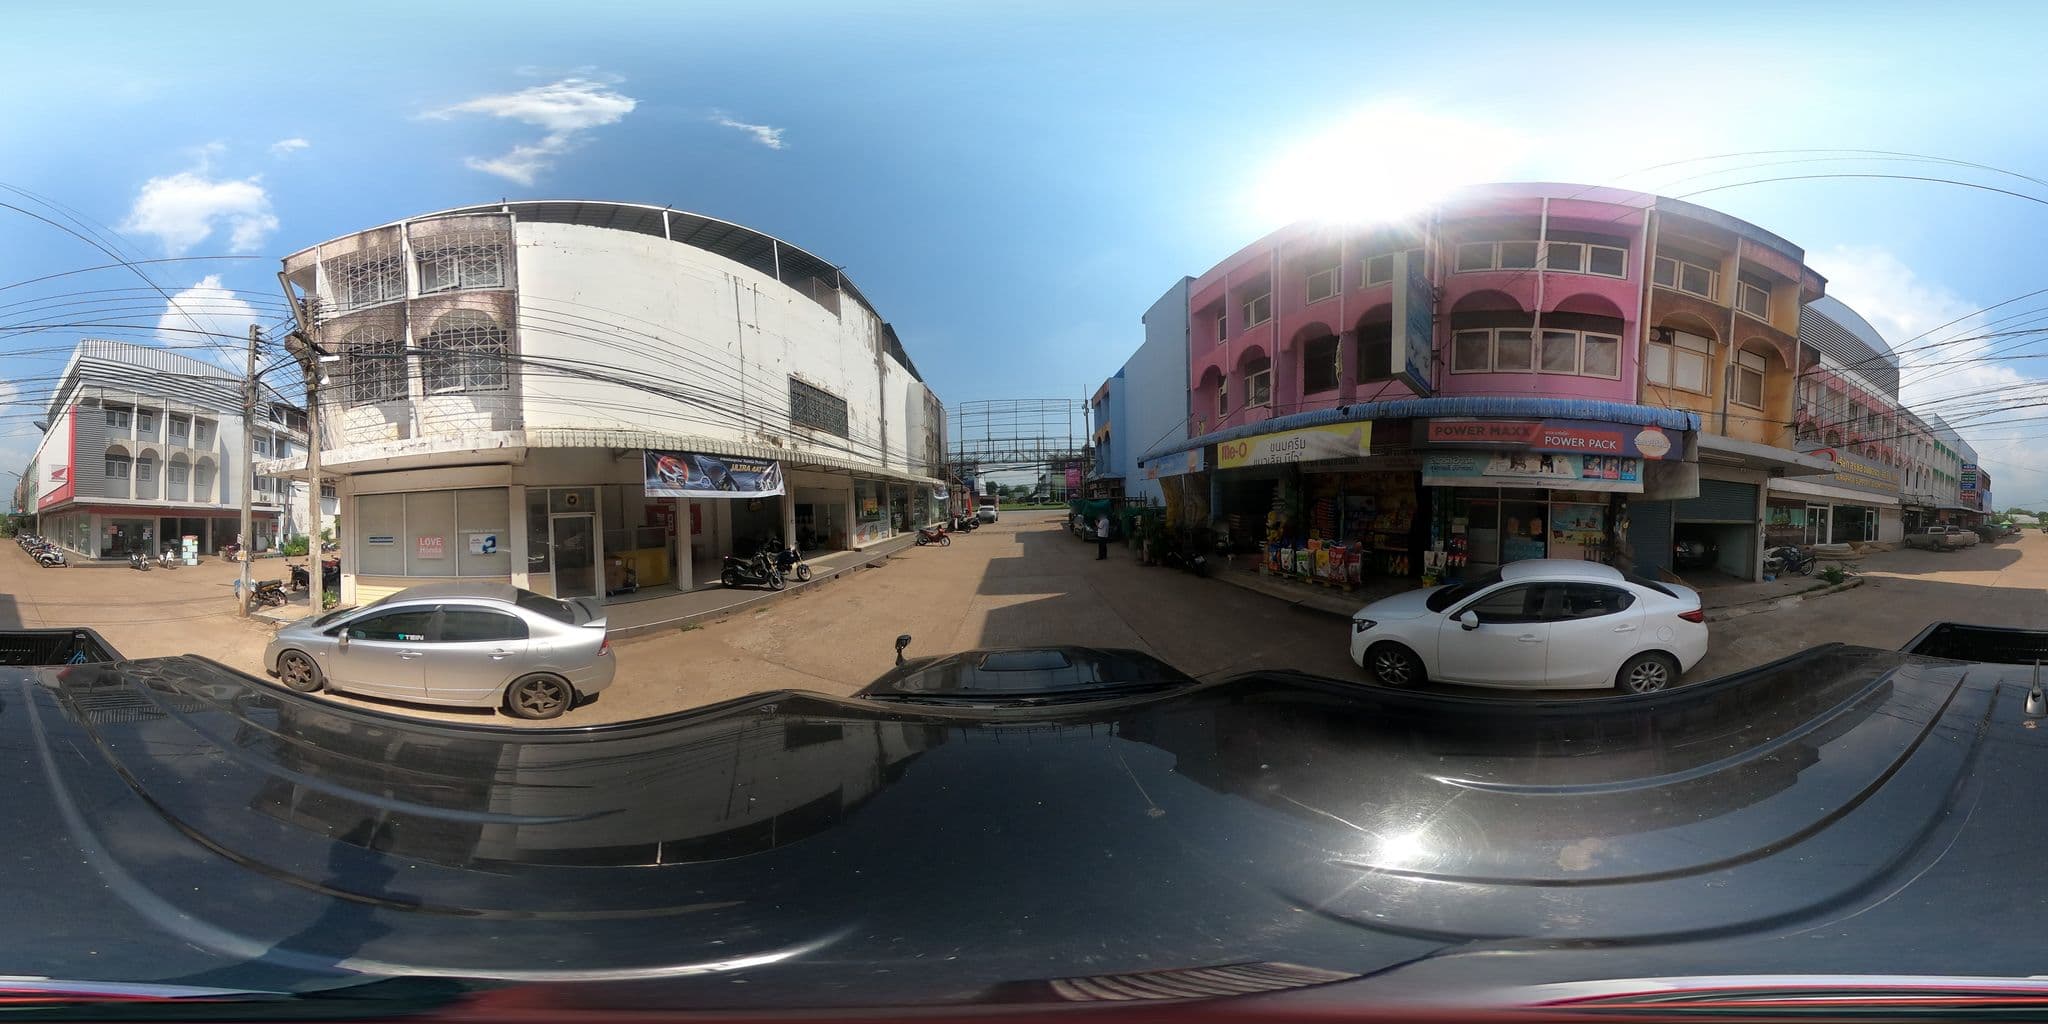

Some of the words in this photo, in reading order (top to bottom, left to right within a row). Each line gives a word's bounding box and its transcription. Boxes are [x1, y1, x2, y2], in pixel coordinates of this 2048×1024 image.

[1434, 426, 1484, 436] POWER
[1544, 436, 1585, 448] POWER
[1589, 438, 1617, 450] PACK
[419, 537, 442, 546] LOVE
